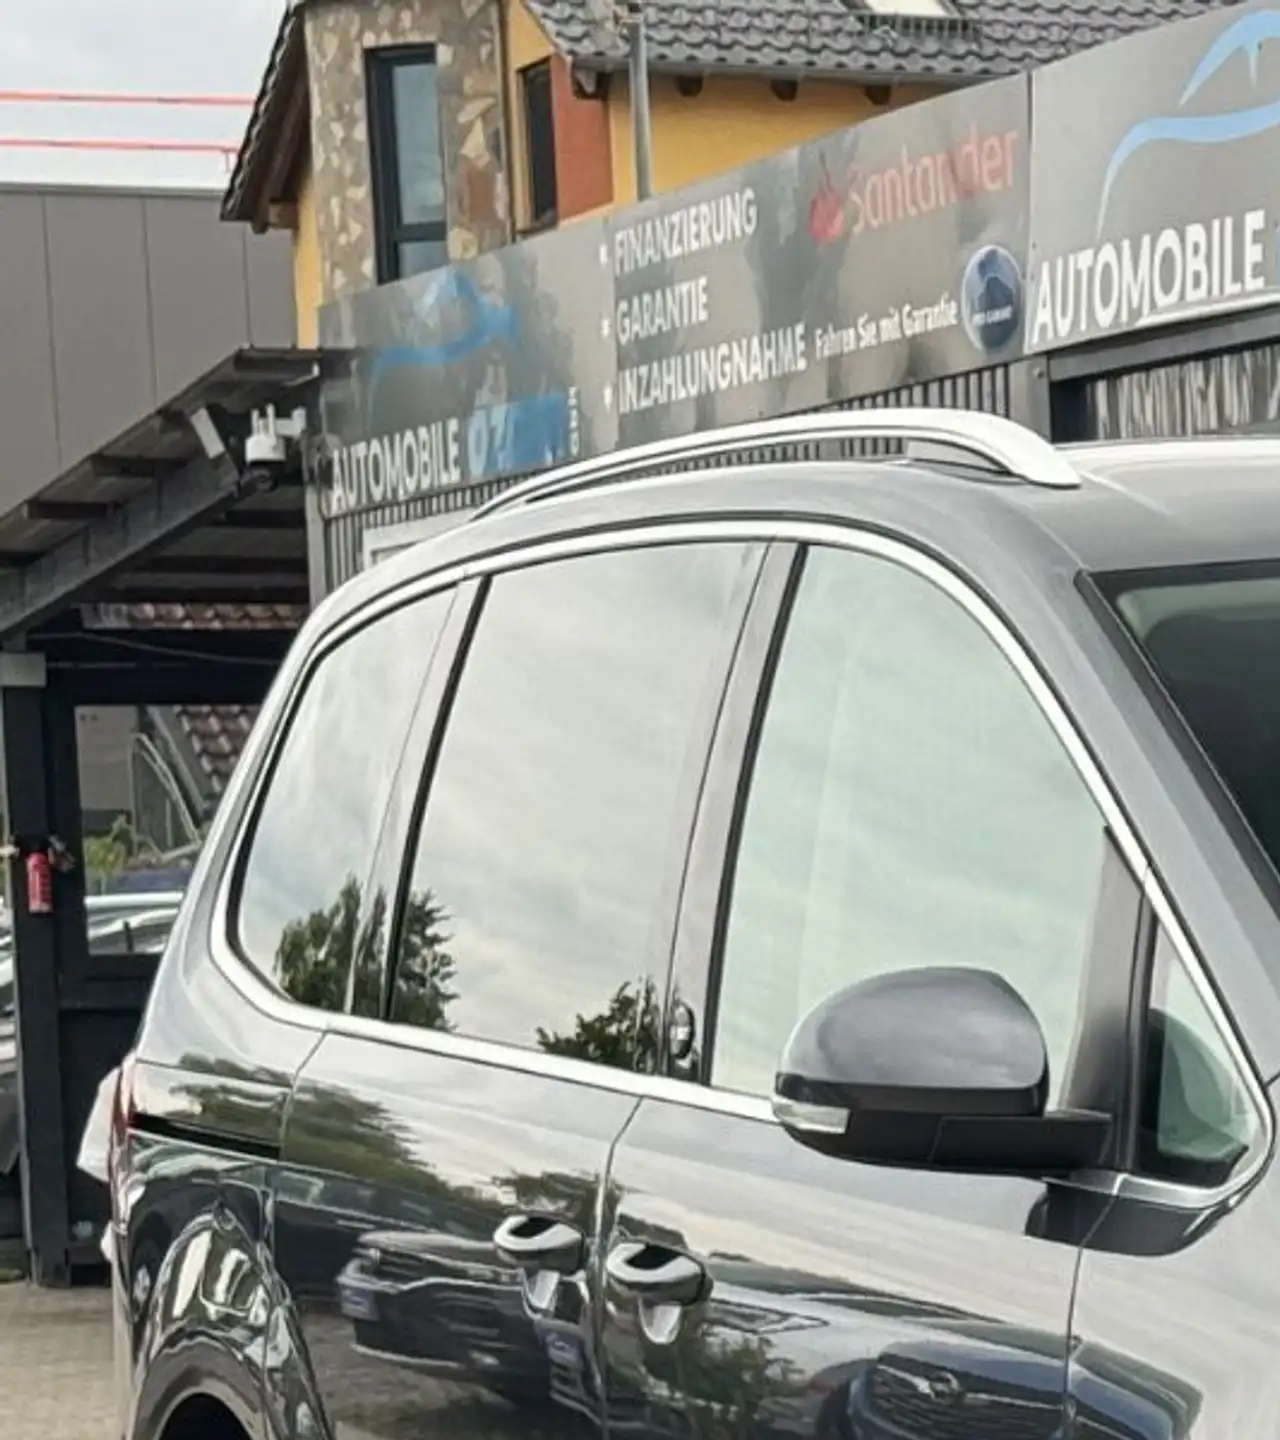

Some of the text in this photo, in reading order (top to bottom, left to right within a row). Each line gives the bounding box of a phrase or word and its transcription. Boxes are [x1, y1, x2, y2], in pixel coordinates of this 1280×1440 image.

[615, 188, 757, 275] FINANZIERUNG
[1032, 209, 1266, 345] AUTOMOBILE
[617, 276, 708, 345] GARANTIE
[618, 322, 807, 414] INZAHLUNGNAHME
[331, 417, 461, 518] AUTOMOBILE
